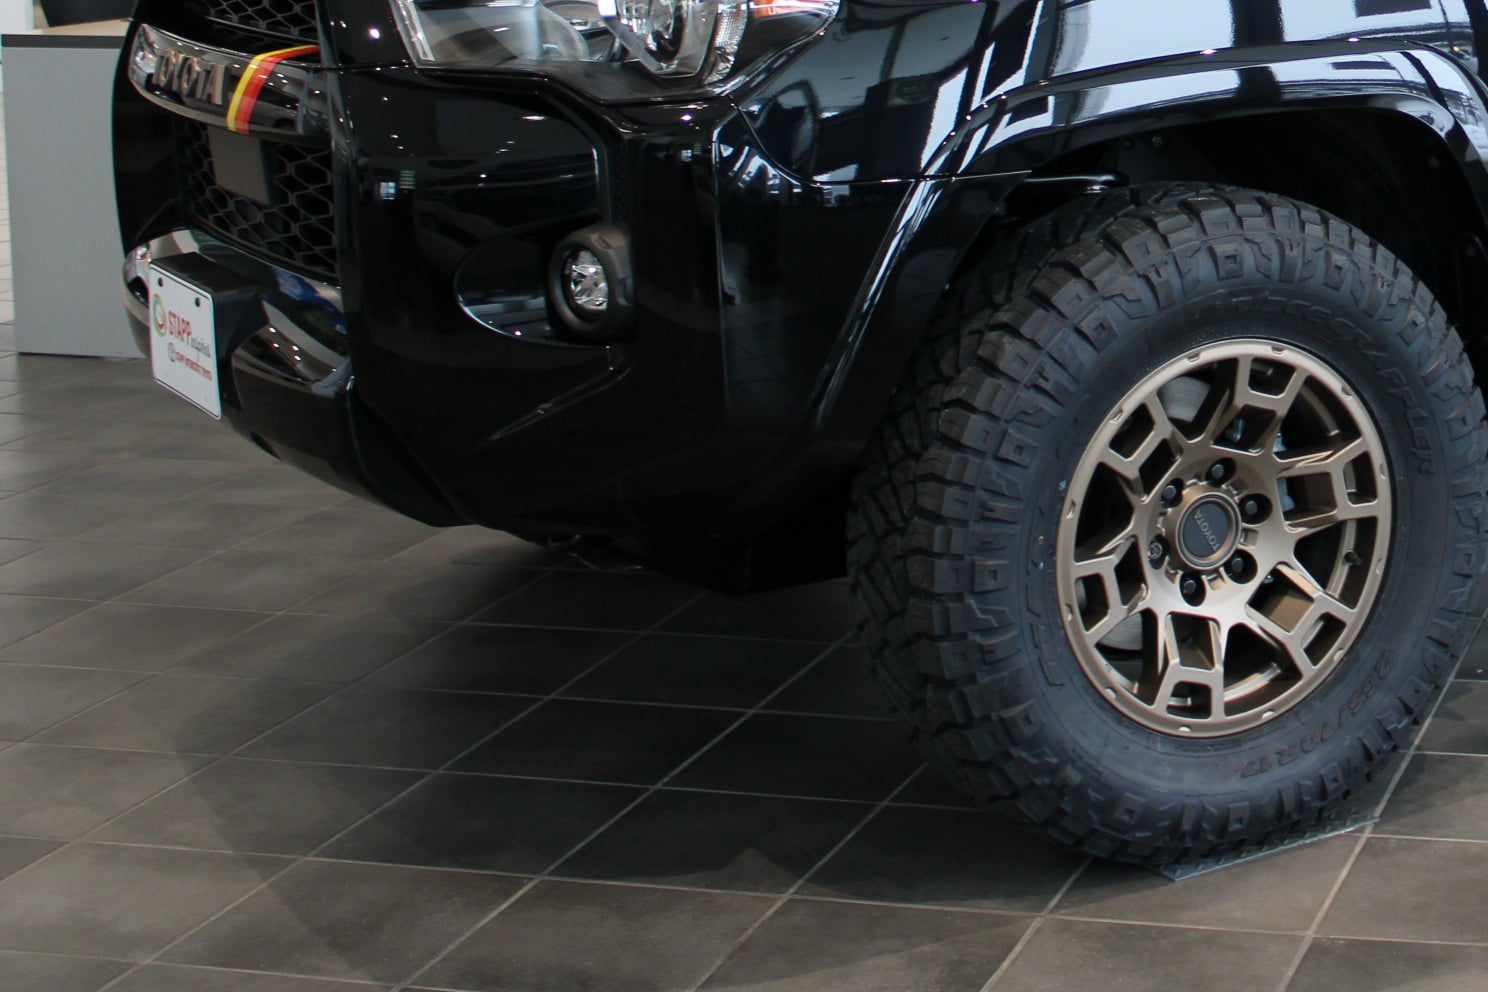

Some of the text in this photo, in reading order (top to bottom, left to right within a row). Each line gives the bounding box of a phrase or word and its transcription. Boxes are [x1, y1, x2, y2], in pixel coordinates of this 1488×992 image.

[152, 50, 226, 105] TOYOTA
[168, 310, 192, 345] STAPP
[1194, 509, 1221, 552] TOYOTA
